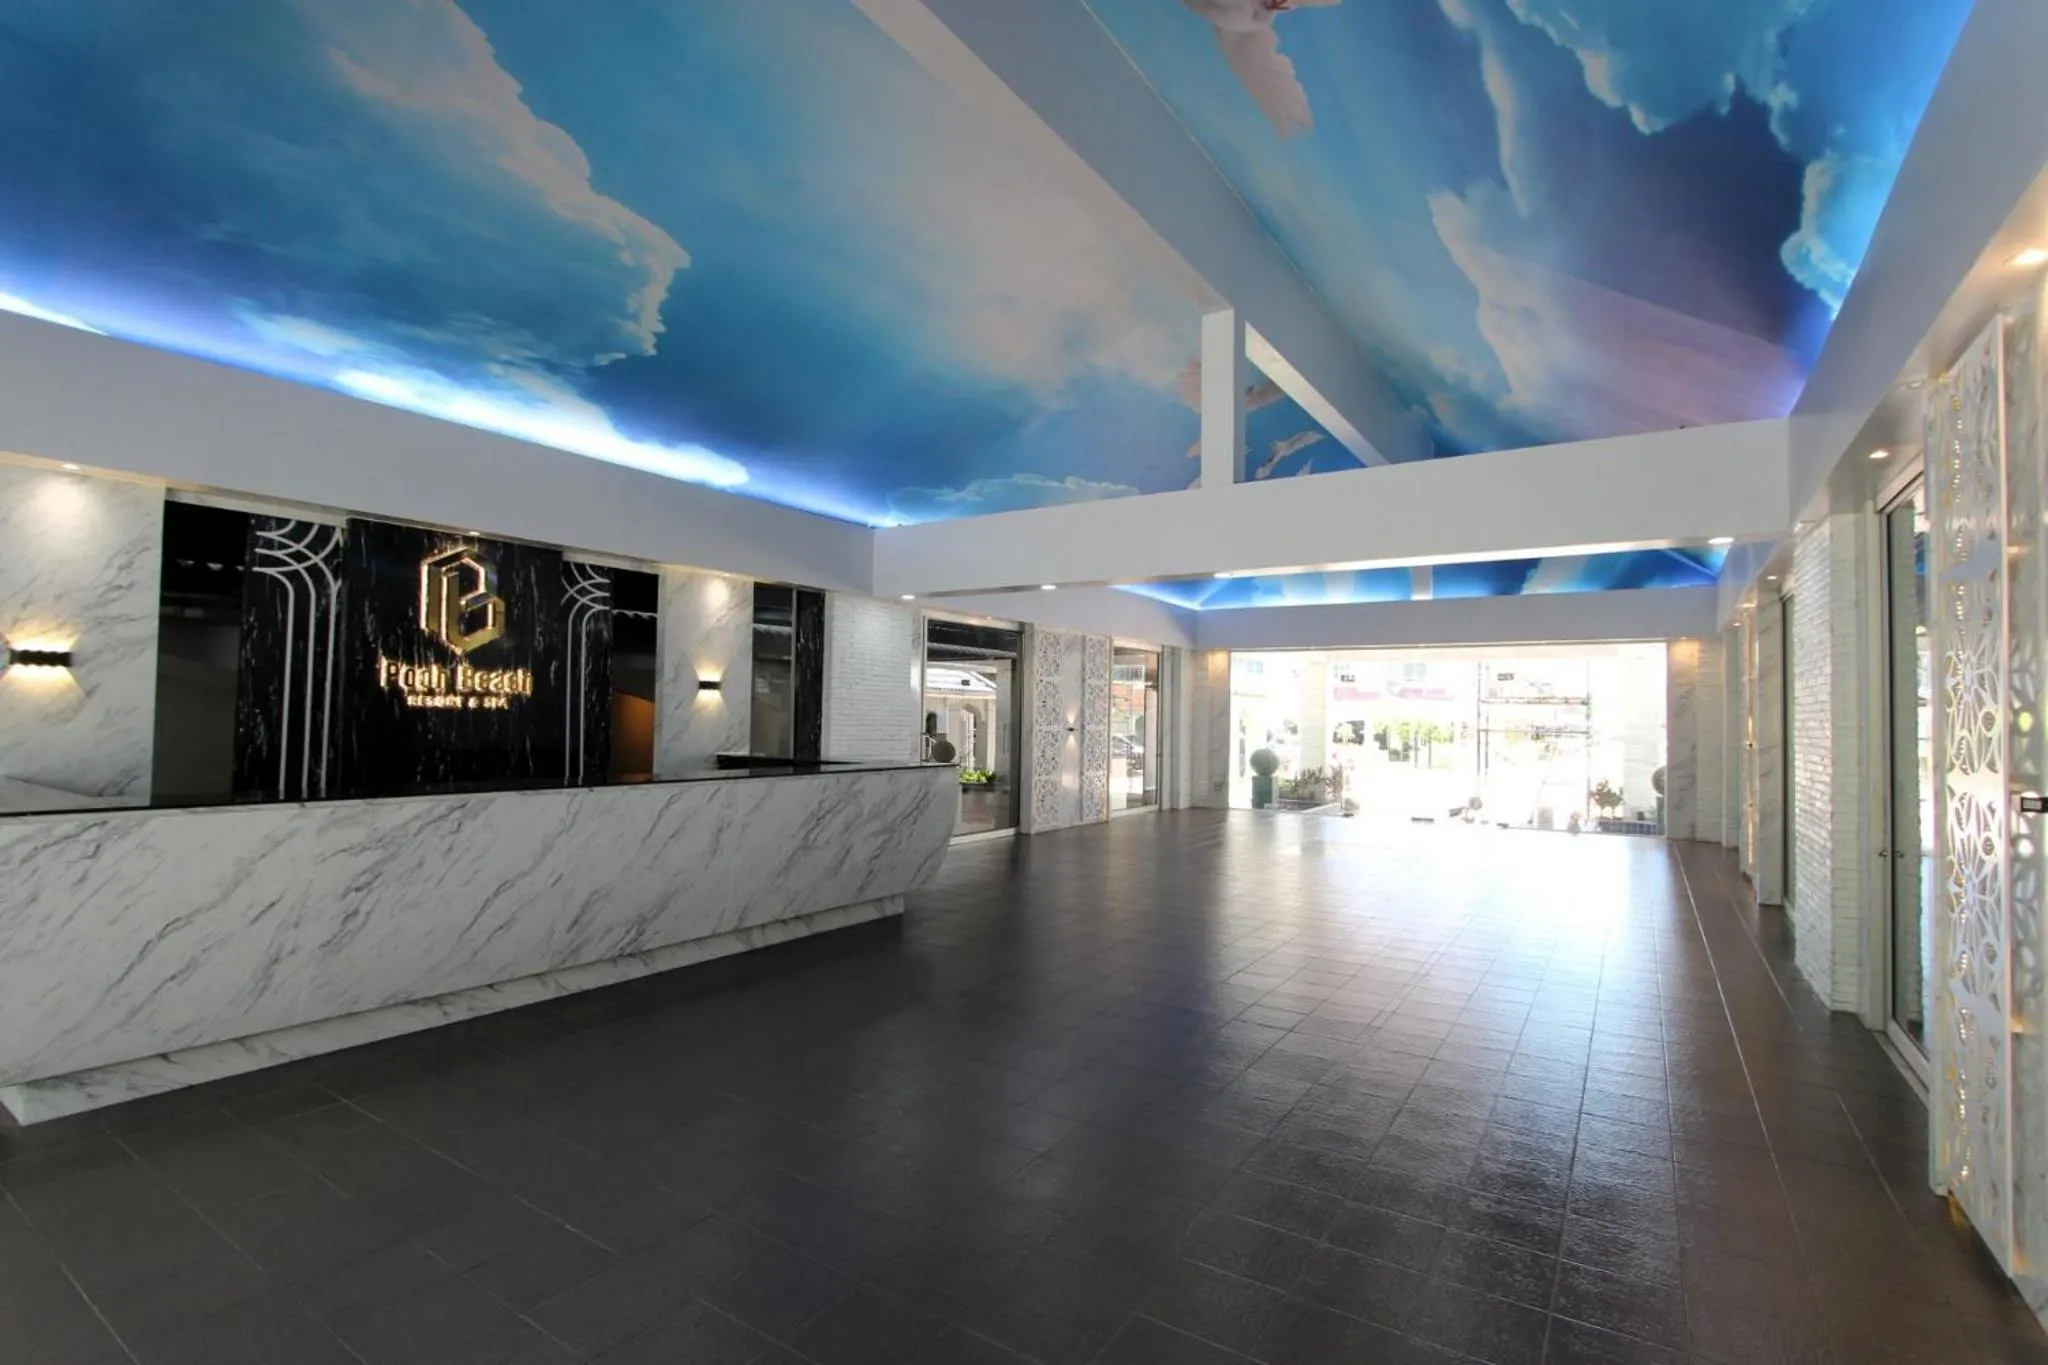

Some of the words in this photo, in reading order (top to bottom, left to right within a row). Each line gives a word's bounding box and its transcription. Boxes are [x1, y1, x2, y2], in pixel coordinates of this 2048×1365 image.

[457, 664, 533, 696] Beach
[406, 694, 462, 708] RESORT
[484, 695, 508, 709] SPA
